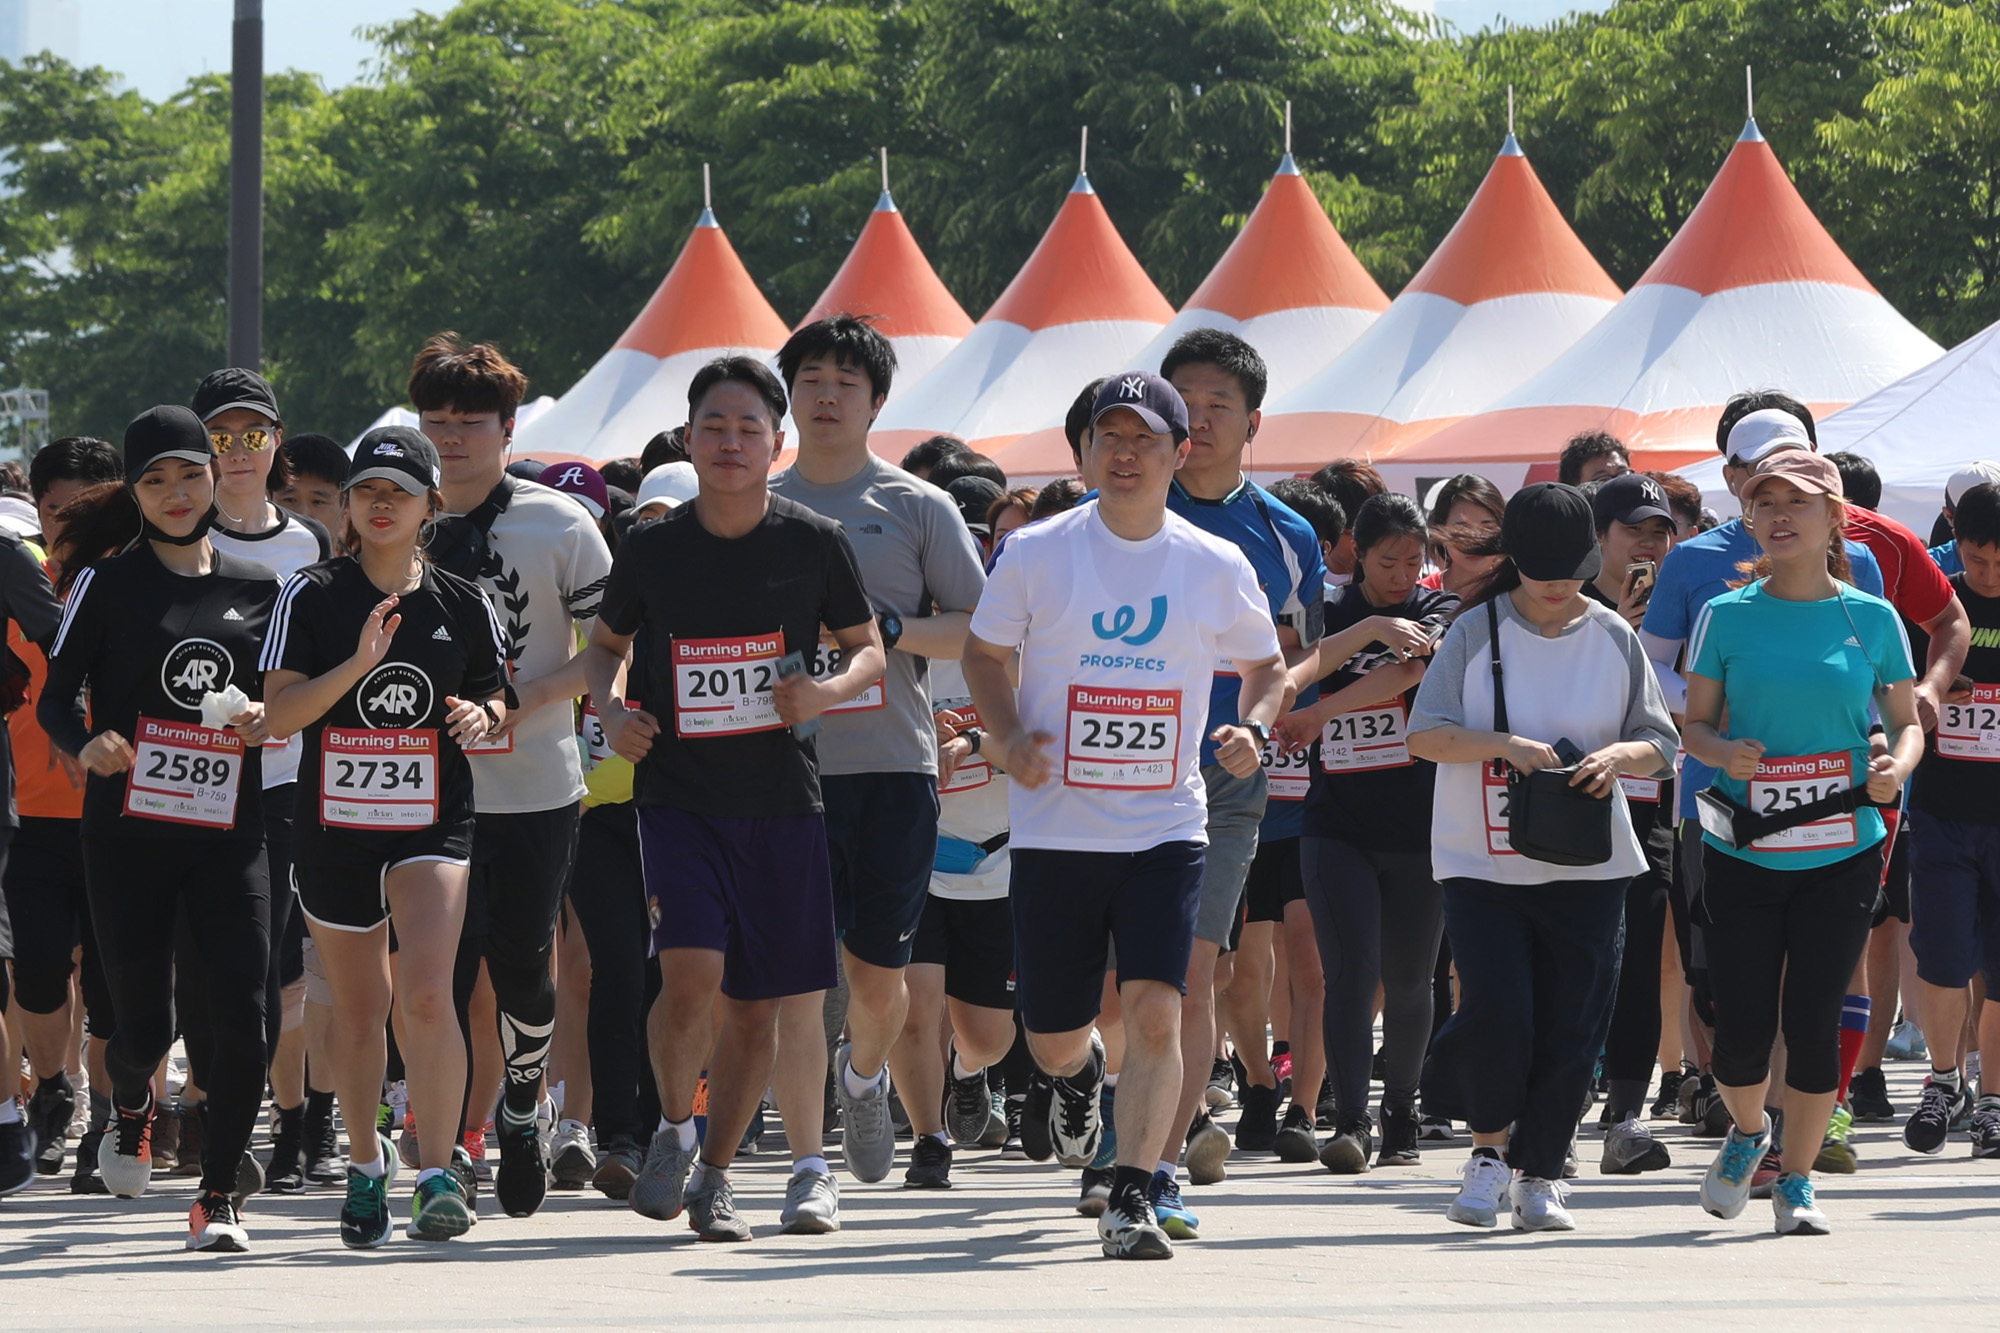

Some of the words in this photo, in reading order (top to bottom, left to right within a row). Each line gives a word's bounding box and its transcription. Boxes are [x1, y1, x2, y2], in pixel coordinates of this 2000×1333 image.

[1119, 376, 1146, 399] NY
[379, 443, 397, 451] NIKE
[554, 466, 585, 487] A
[679, 643, 742, 657] Burning
[745, 641, 777, 654] Run
[171, 659, 219, 690] AR
[813, 649, 841, 677] 68
[1080, 654, 1166, 672] PROSPECS
[688, 665, 773, 698] 2012
[367, 684, 417, 716] AR
[1076, 691, 1142, 710] Burning
[1146, 695, 1174, 708] Run
[1330, 713, 1396, 741] 2132
[1946, 705, 2000, 730] 312
[145, 723, 210, 746] Burning
[212, 732, 240, 746] Run
[329, 732, 395, 750] Burning
[398, 734, 430, 747] Run
[1081, 719, 1166, 750] 2525
[1260, 746, 1309, 769] 659
[1320, 747, 1347, 757] A-142
[145, 750, 230, 787] 2589
[335, 760, 424, 789] 2734
[1132, 764, 1164, 775] A-423
[1755, 761, 1816, 774] Burning
[1819, 758, 1845, 770] Run
[196, 787, 227, 802] B-759
[1762, 782, 1840, 814] 2516
